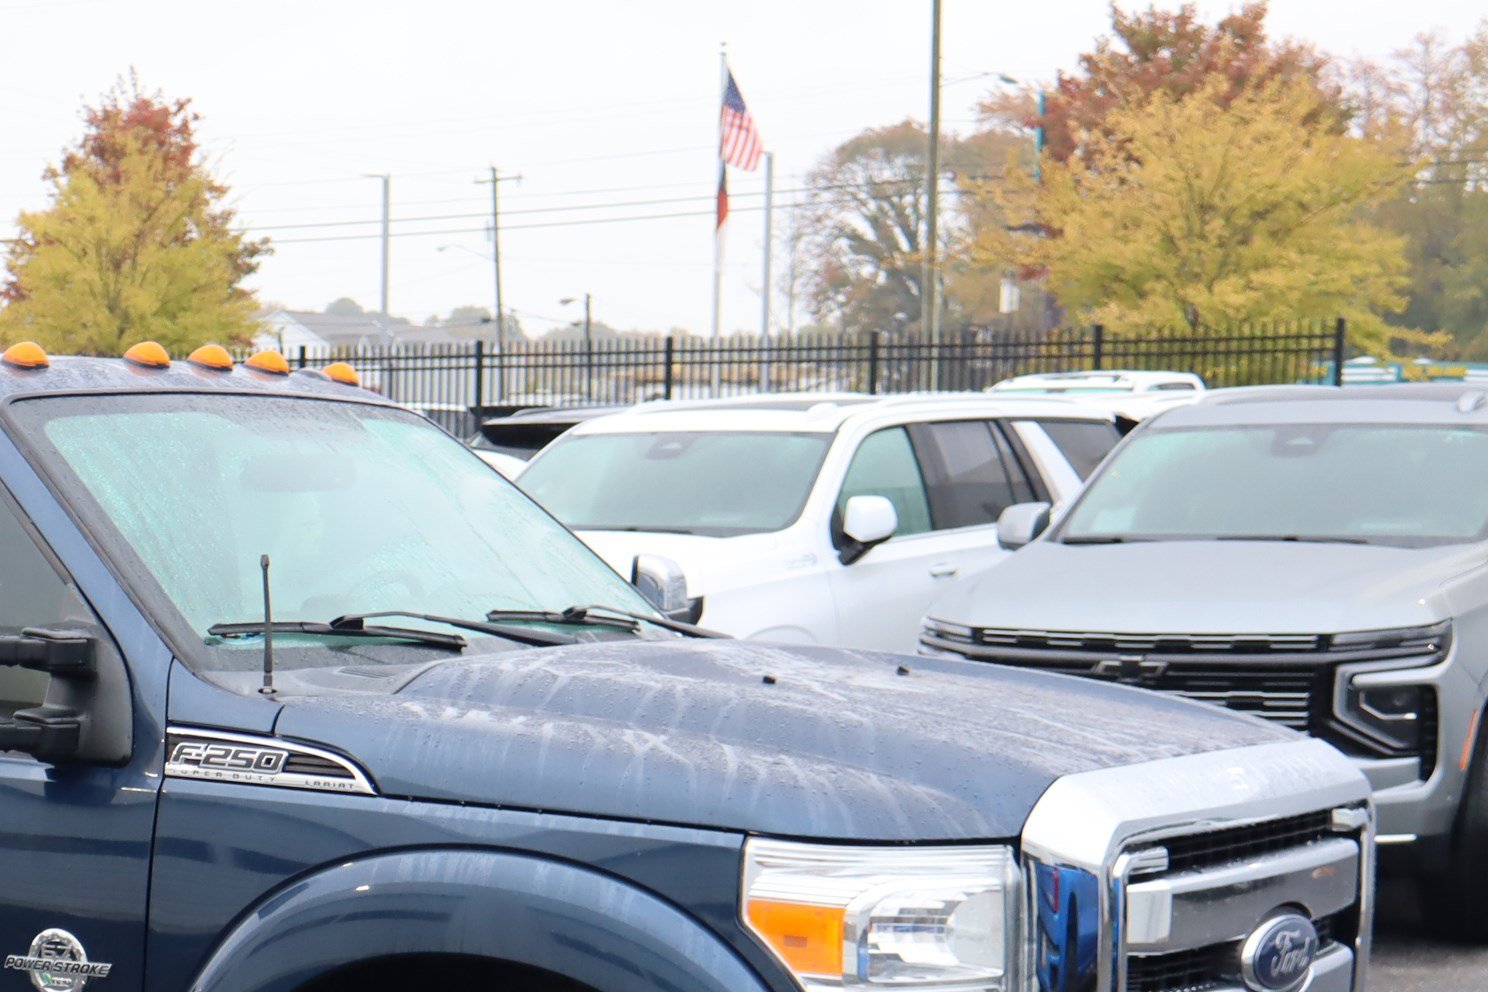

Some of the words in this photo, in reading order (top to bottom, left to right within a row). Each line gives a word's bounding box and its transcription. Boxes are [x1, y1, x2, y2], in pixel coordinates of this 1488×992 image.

[170, 742, 289, 774] F-250
[232, 773, 276, 782] DUTY
[305, 780, 355, 789] LARIAT
[1270, 930, 1311, 977] Ford
[4, 957, 52, 971] POWER
[52, 961, 110, 976] STROKE
